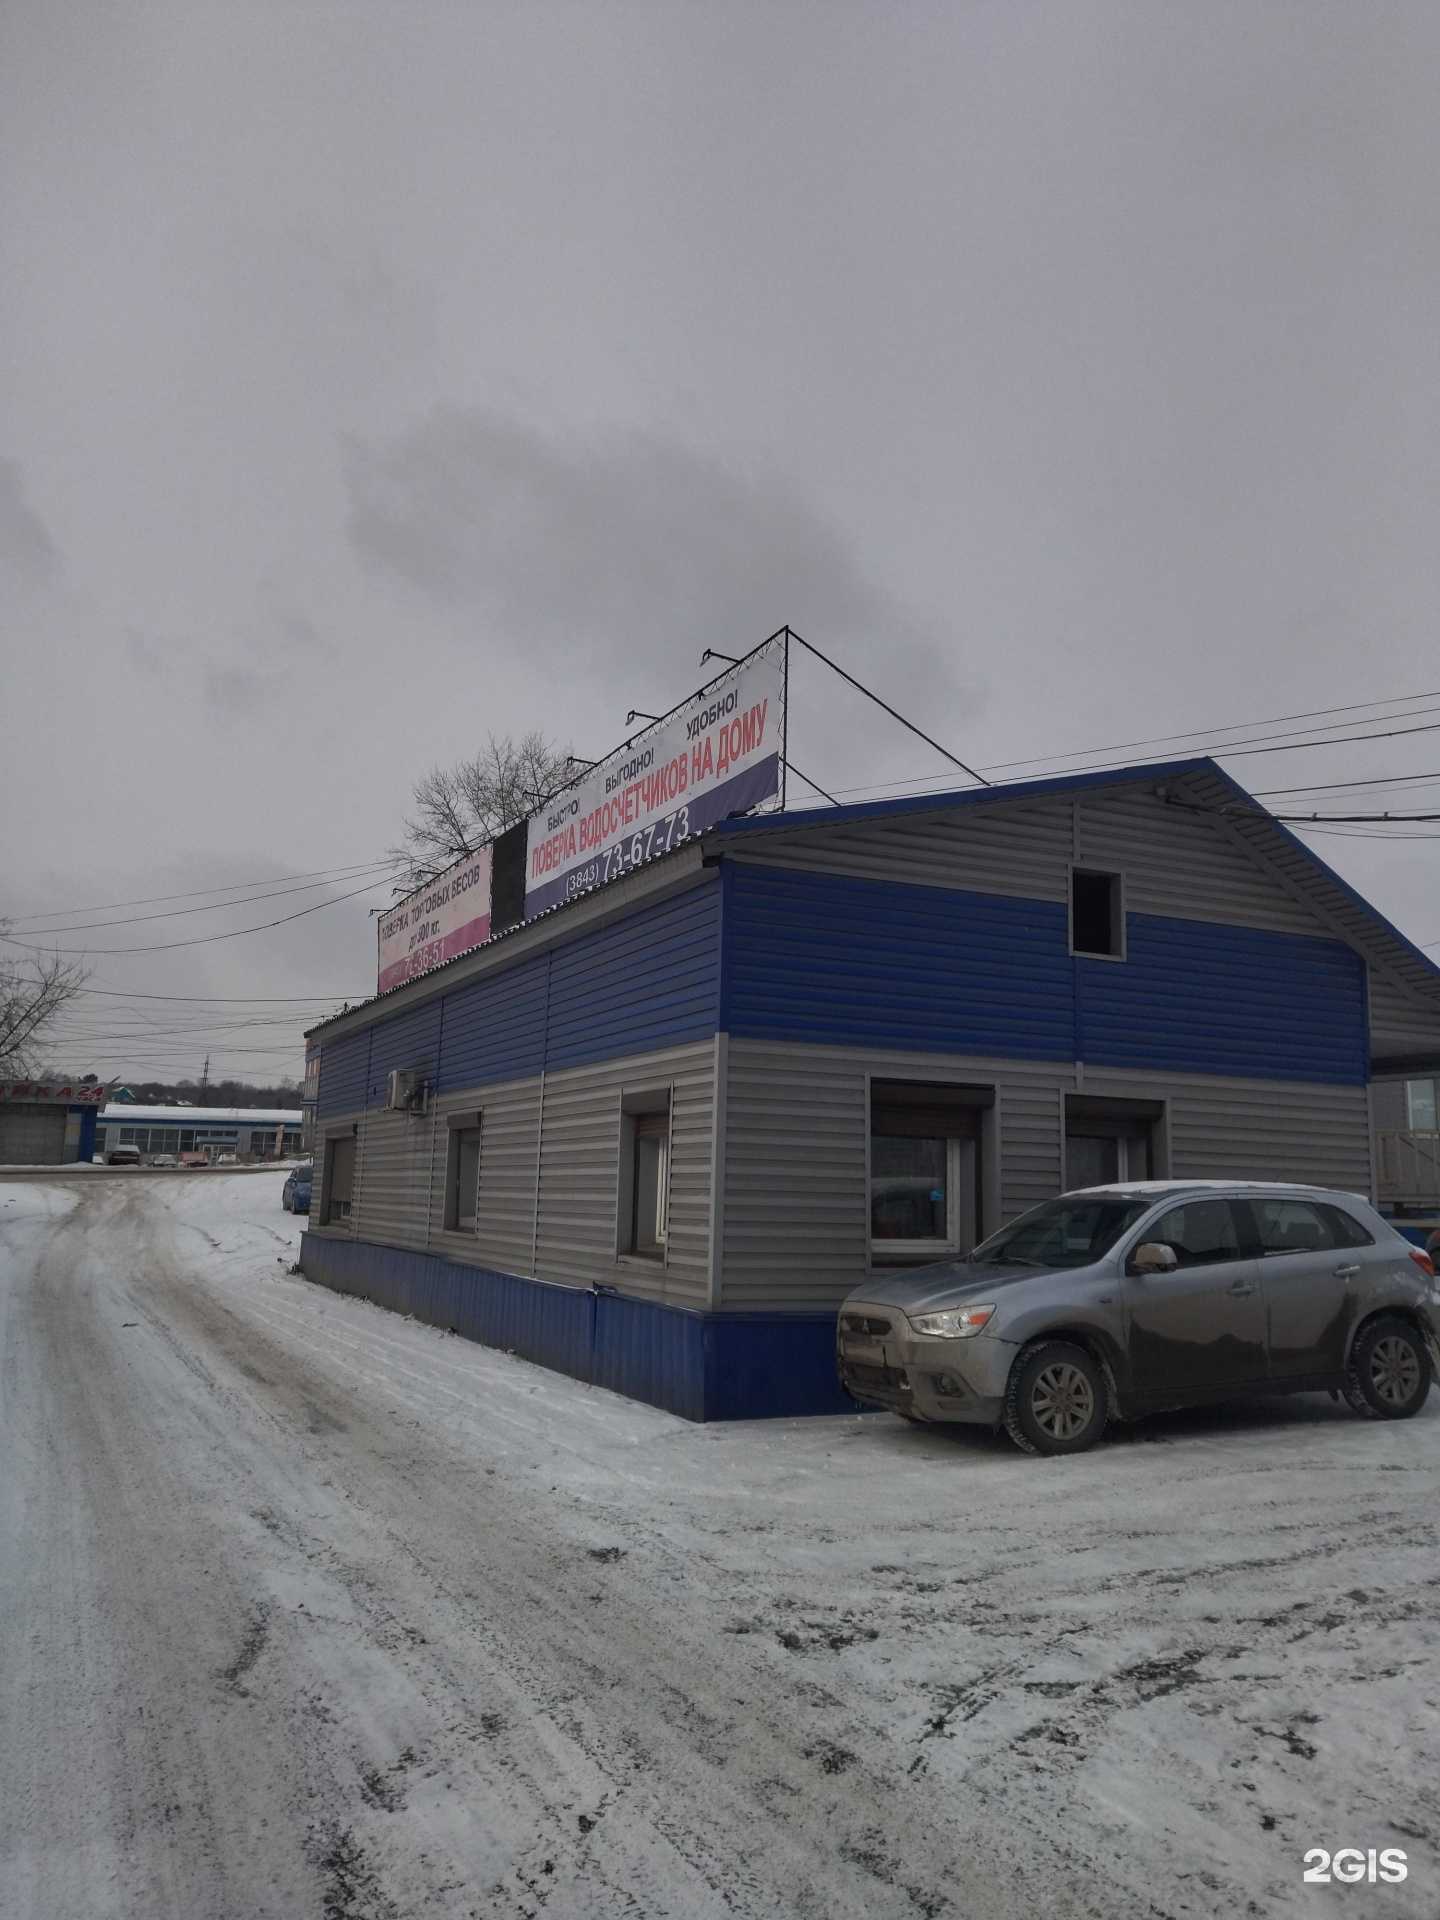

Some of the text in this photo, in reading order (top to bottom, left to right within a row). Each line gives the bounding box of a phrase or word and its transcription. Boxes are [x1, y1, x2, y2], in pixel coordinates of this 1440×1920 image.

[531, 698, 769, 880] ПОВЕРКА ВОДОСЧЕТЧИКОВ НА ДОМУ
[605, 747, 655, 794] ВЫГОДНО!
[686, 689, 739, 740] УДОБНО!
[411, 883, 451, 925] ТОРГОВЫХ
[451, 865, 480, 901] ВЕСОВ
[566, 806, 689, 896] (3843) 73-67-73
